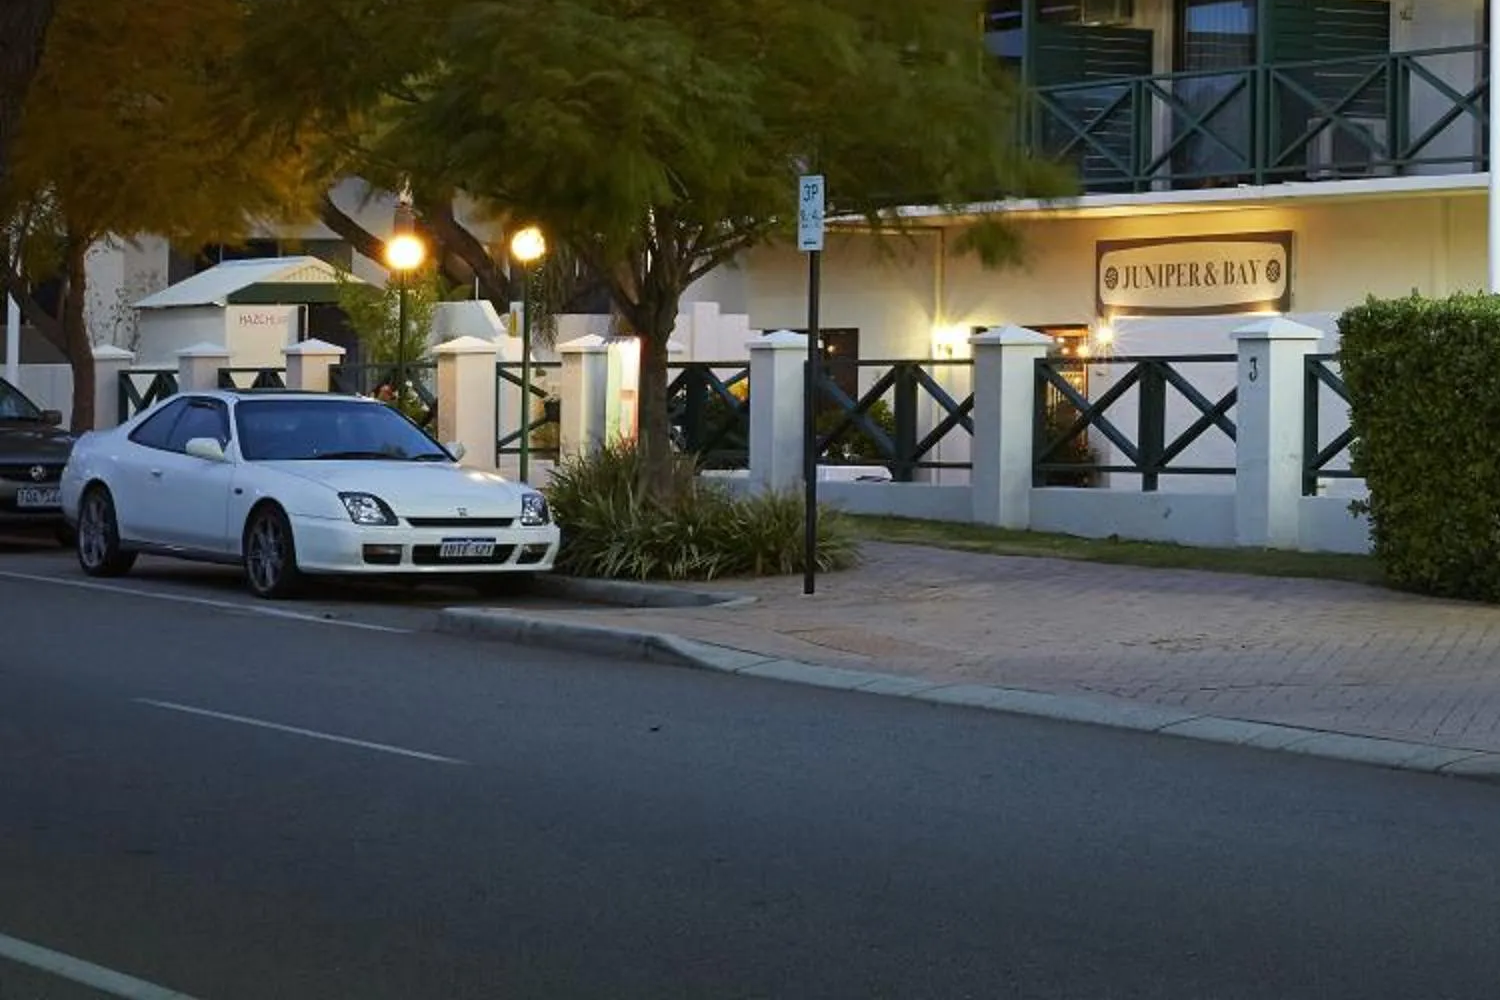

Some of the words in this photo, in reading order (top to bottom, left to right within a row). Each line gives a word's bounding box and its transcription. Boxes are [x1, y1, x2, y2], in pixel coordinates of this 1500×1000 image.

[1121, 261, 1201, 289] JUNIPER
[1203, 261, 1217, 287] &
[1223, 259, 1261, 286] BAY
[1249, 357, 1258, 382] 3
